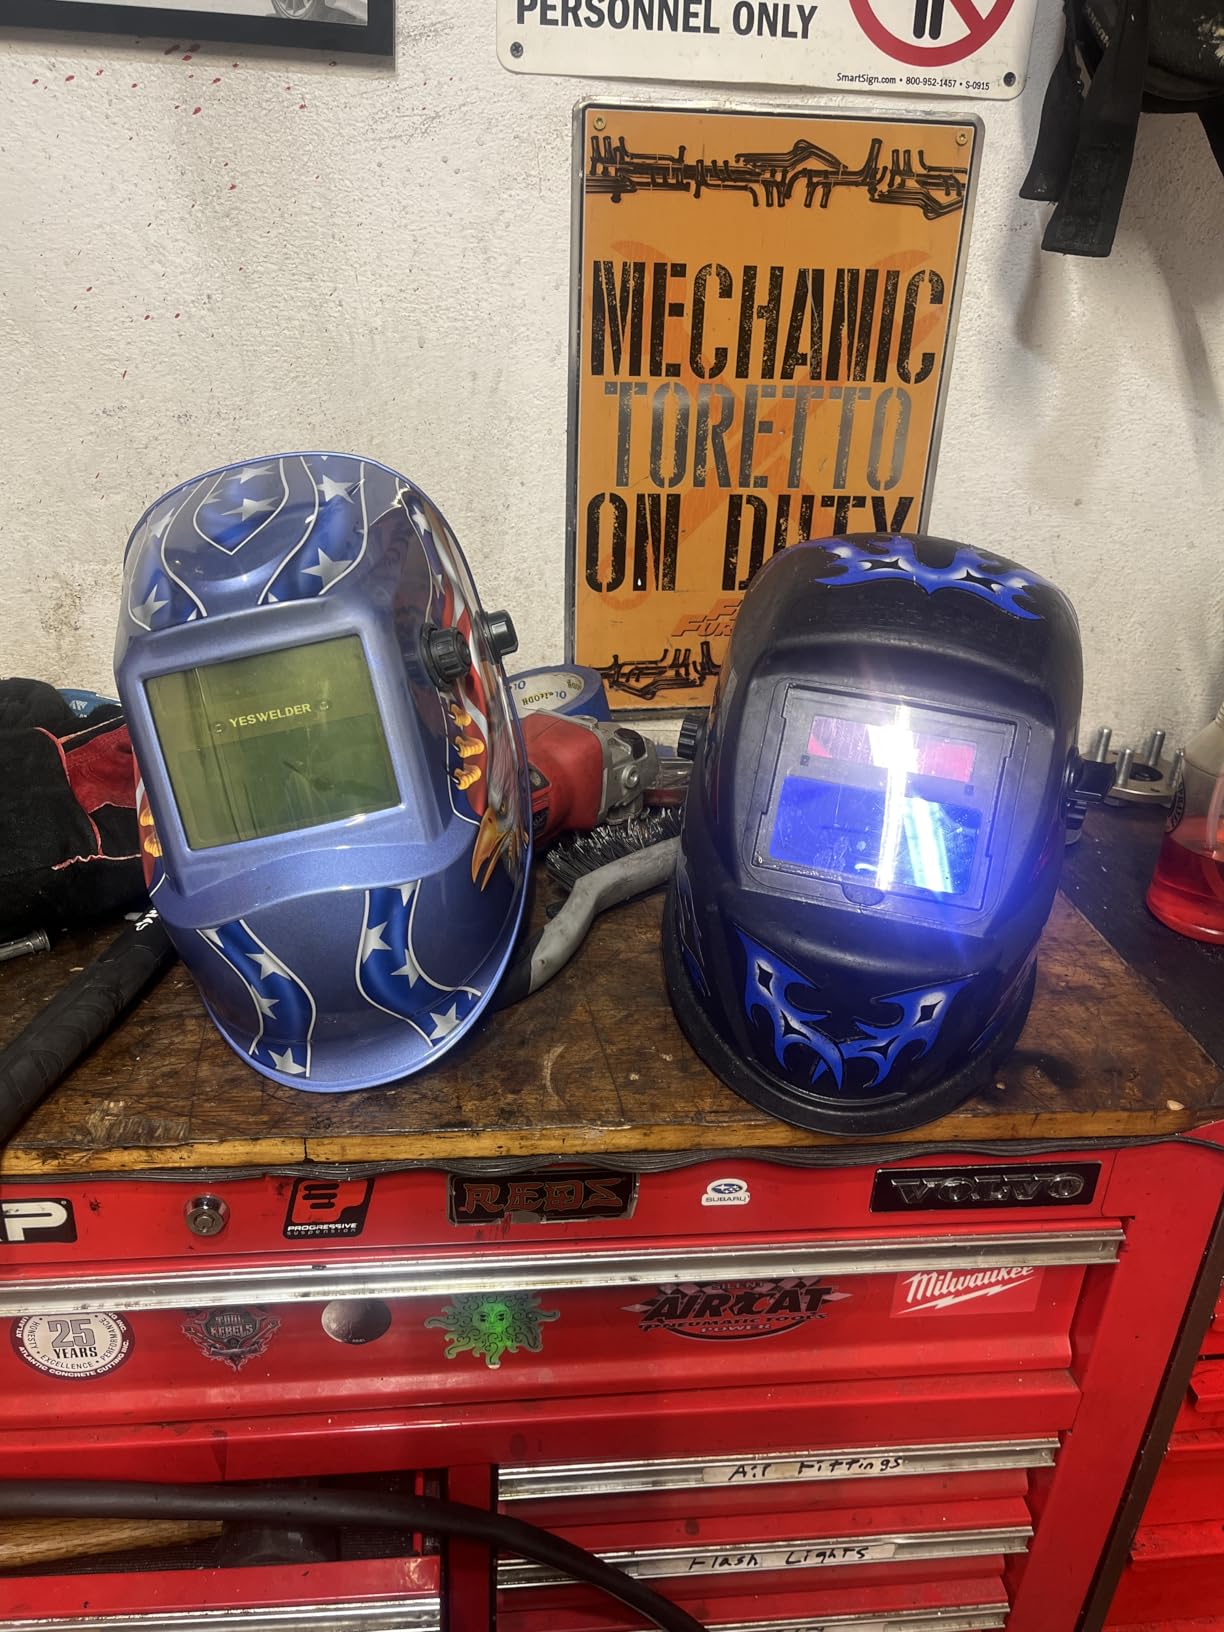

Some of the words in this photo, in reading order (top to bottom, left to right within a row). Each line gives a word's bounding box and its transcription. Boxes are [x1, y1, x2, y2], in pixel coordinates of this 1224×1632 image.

[516, 0, 720, 34] PERSONNEL
[732, 0, 818, 39] ONLY
[837, 72, 897, 86] SmartSign.com
[905, 76, 957, 88] 800-952-1457
[965, 81, 990, 91] S-0915
[591, 260, 945, 384] MECHANIC
[604, 382, 912, 491] TORETTO
[585, 492, 681, 592] ON
[229, 703, 312, 728] YESWELDER
[891, 1172, 1085, 1204] VOLVO
[287, 1222, 358, 1231] PROGRESSIVE
[902, 1265, 1034, 1304] Milwaukee
[641, 1287, 833, 1322] AIRCAT
[27, 1321, 41, 1350] HONESTY
[40, 1354, 94, 1370] EXCELLENCE
[100, 1317, 118, 1361] PERFORMANCE
[47, 1318, 96, 1349] 25
[210, 1323, 254, 1338] REBELS
[18, 1346, 49, 1371] ATLANTIC
[48, 1368, 97, 1378] CONCRETE
[96, 1354, 125, 1374] CUTTING
[53, 1346, 98, 1359] YEARS
[728, 1463, 772, 1481] Air
[688, 1553, 760, 1571] Flash
